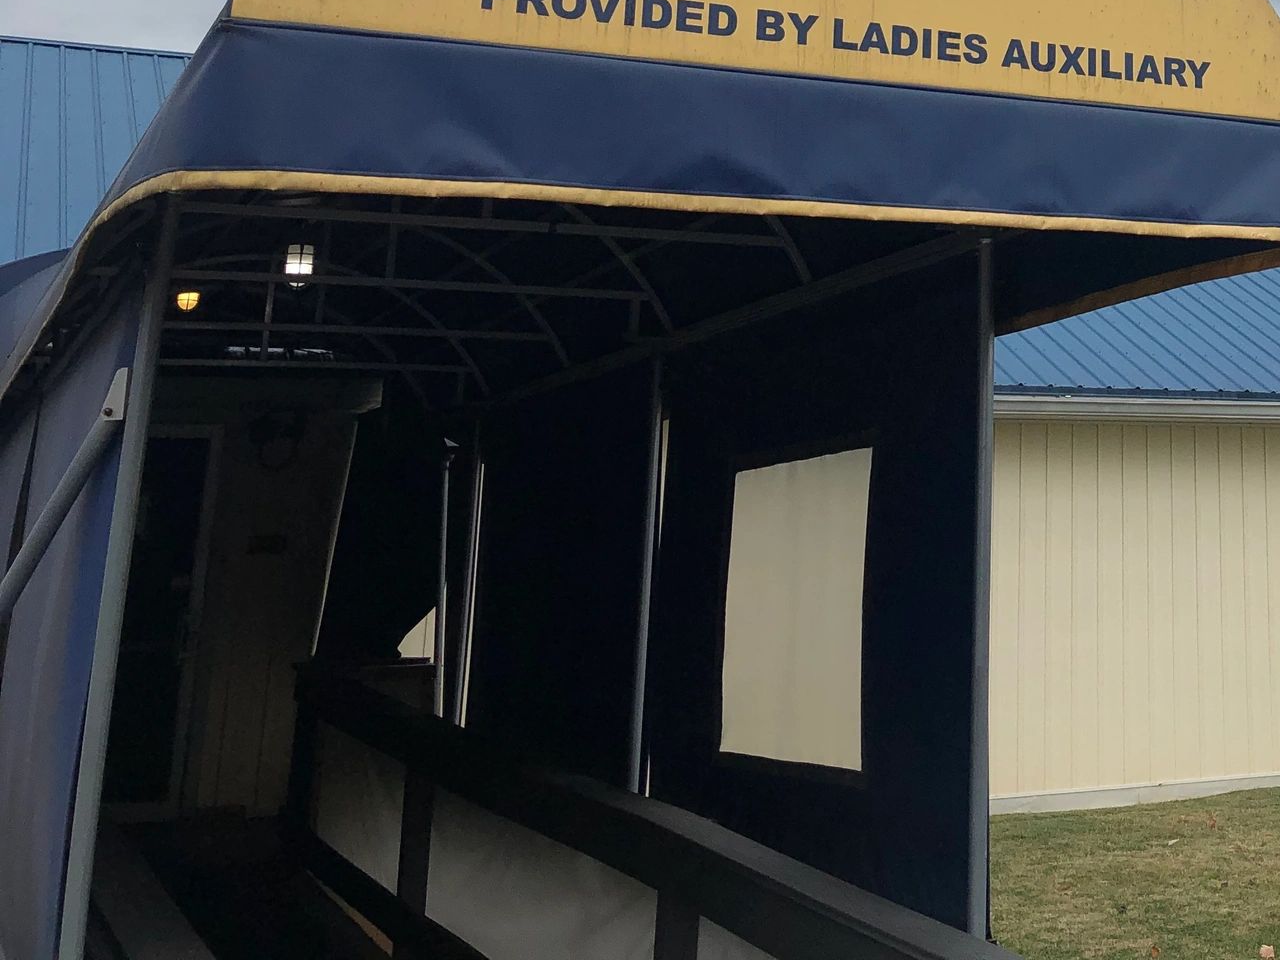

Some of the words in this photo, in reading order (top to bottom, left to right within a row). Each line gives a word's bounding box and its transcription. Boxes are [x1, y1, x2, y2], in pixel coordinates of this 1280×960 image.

[756, 8, 818, 46] BY
[832, 18, 988, 65] LADIES
[1001, 38, 1211, 90] AUXILIARY
